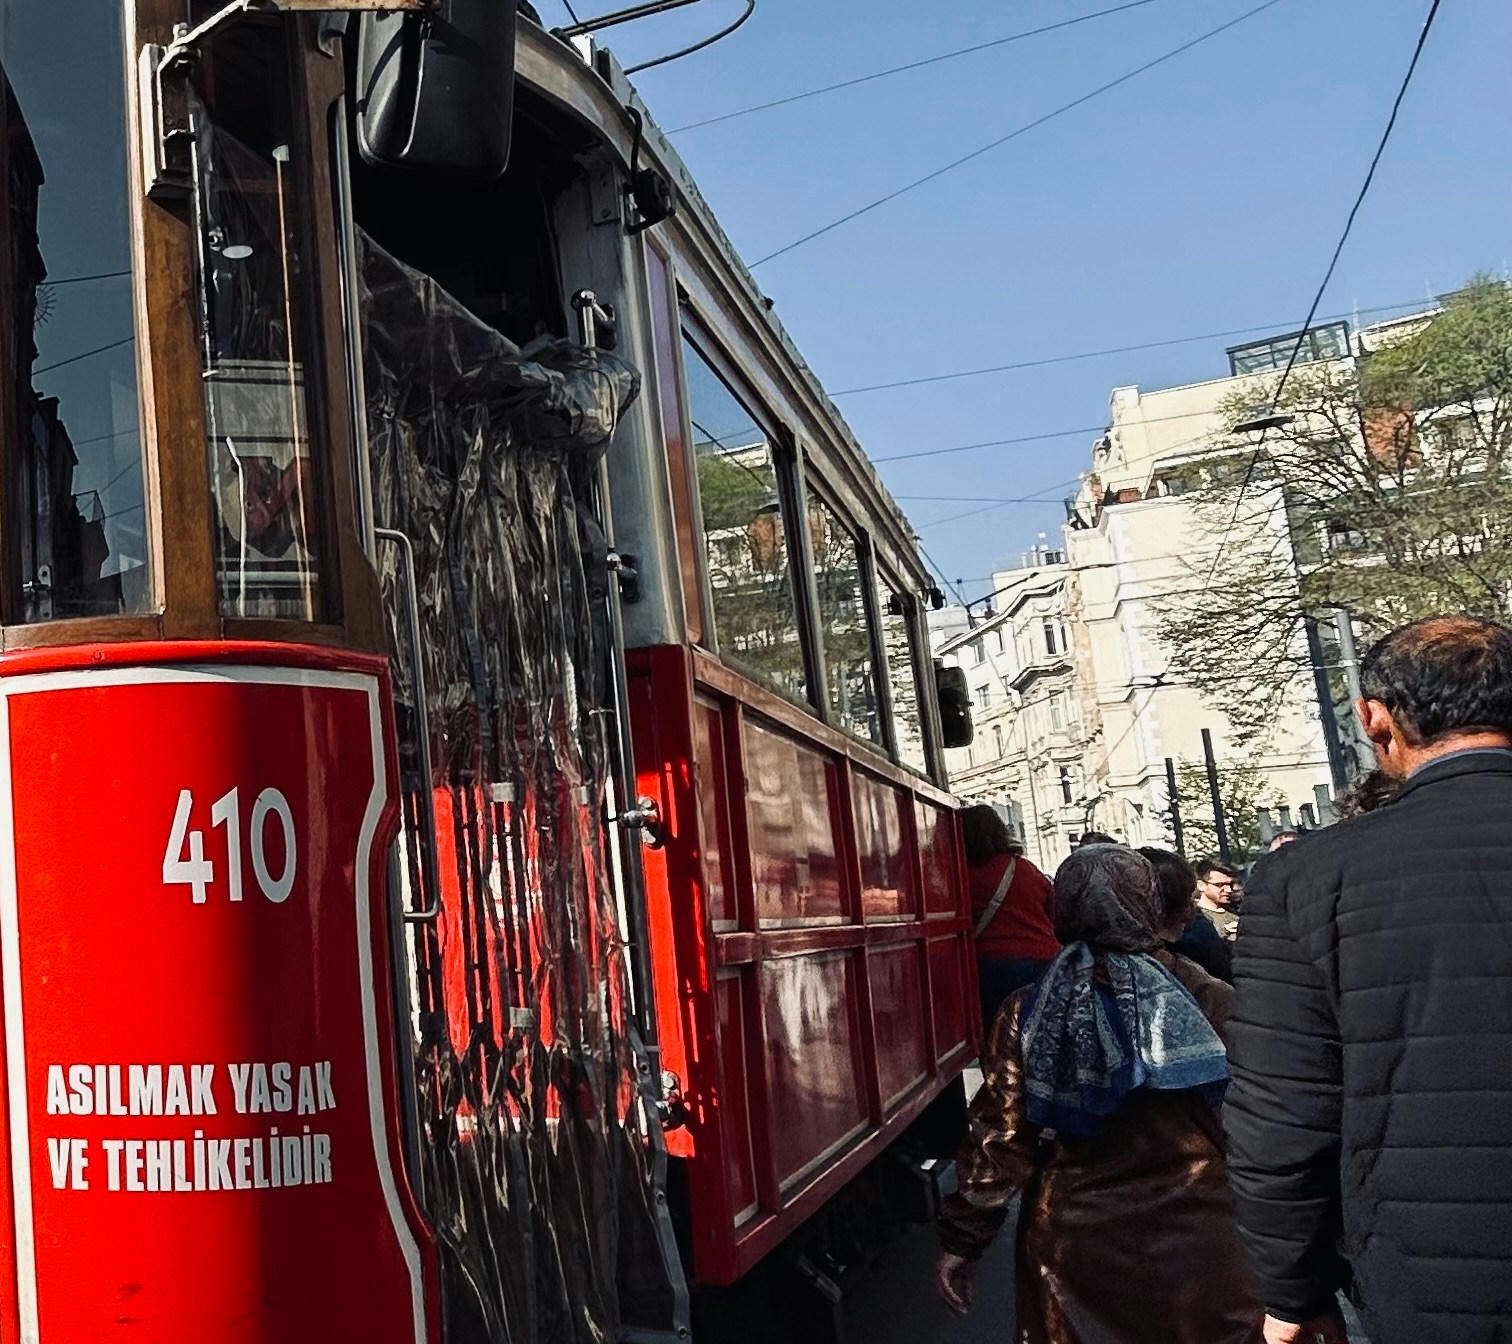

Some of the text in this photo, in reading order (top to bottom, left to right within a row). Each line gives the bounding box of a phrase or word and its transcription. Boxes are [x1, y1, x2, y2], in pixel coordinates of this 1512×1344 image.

[162, 786, 297, 904] 410
[46, 1061, 337, 1116] ASILMAK YASAK
[47, 1124, 332, 1192] VE TEHLİKELİDİR
